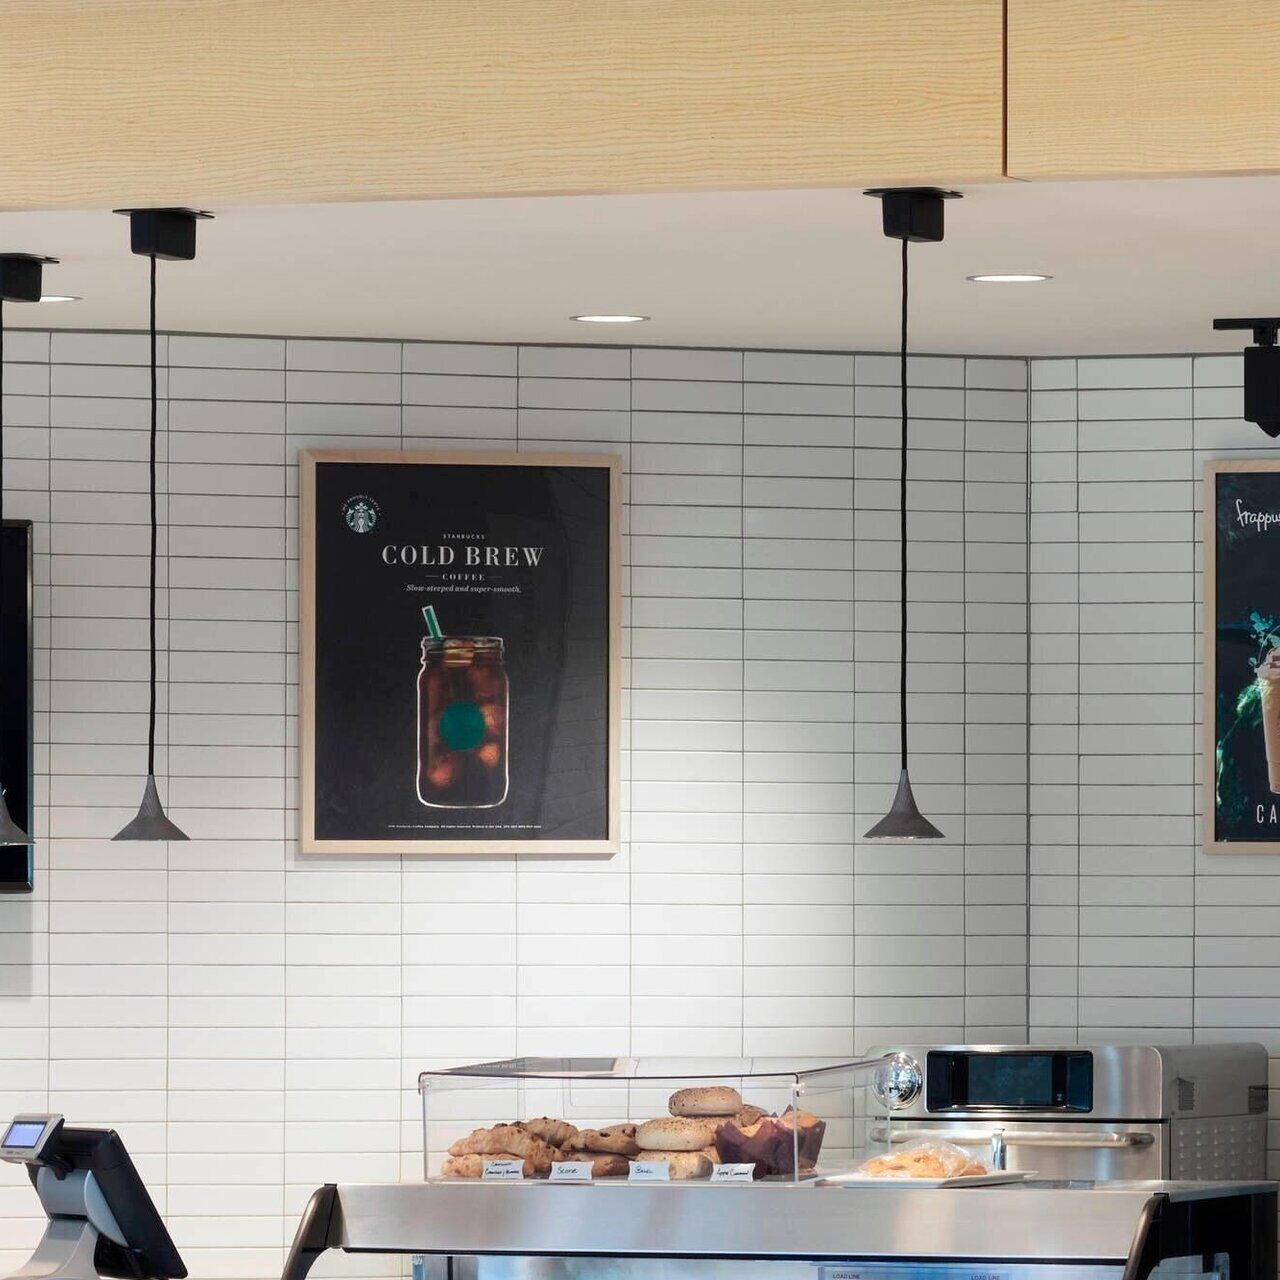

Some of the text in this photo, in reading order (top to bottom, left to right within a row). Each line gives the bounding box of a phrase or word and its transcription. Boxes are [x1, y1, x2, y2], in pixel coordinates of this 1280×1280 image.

[381, 545, 544, 567] COLD BREW
[442, 573, 485, 581] COFFEE
[406, 584, 454, 593] Slow-steeped
